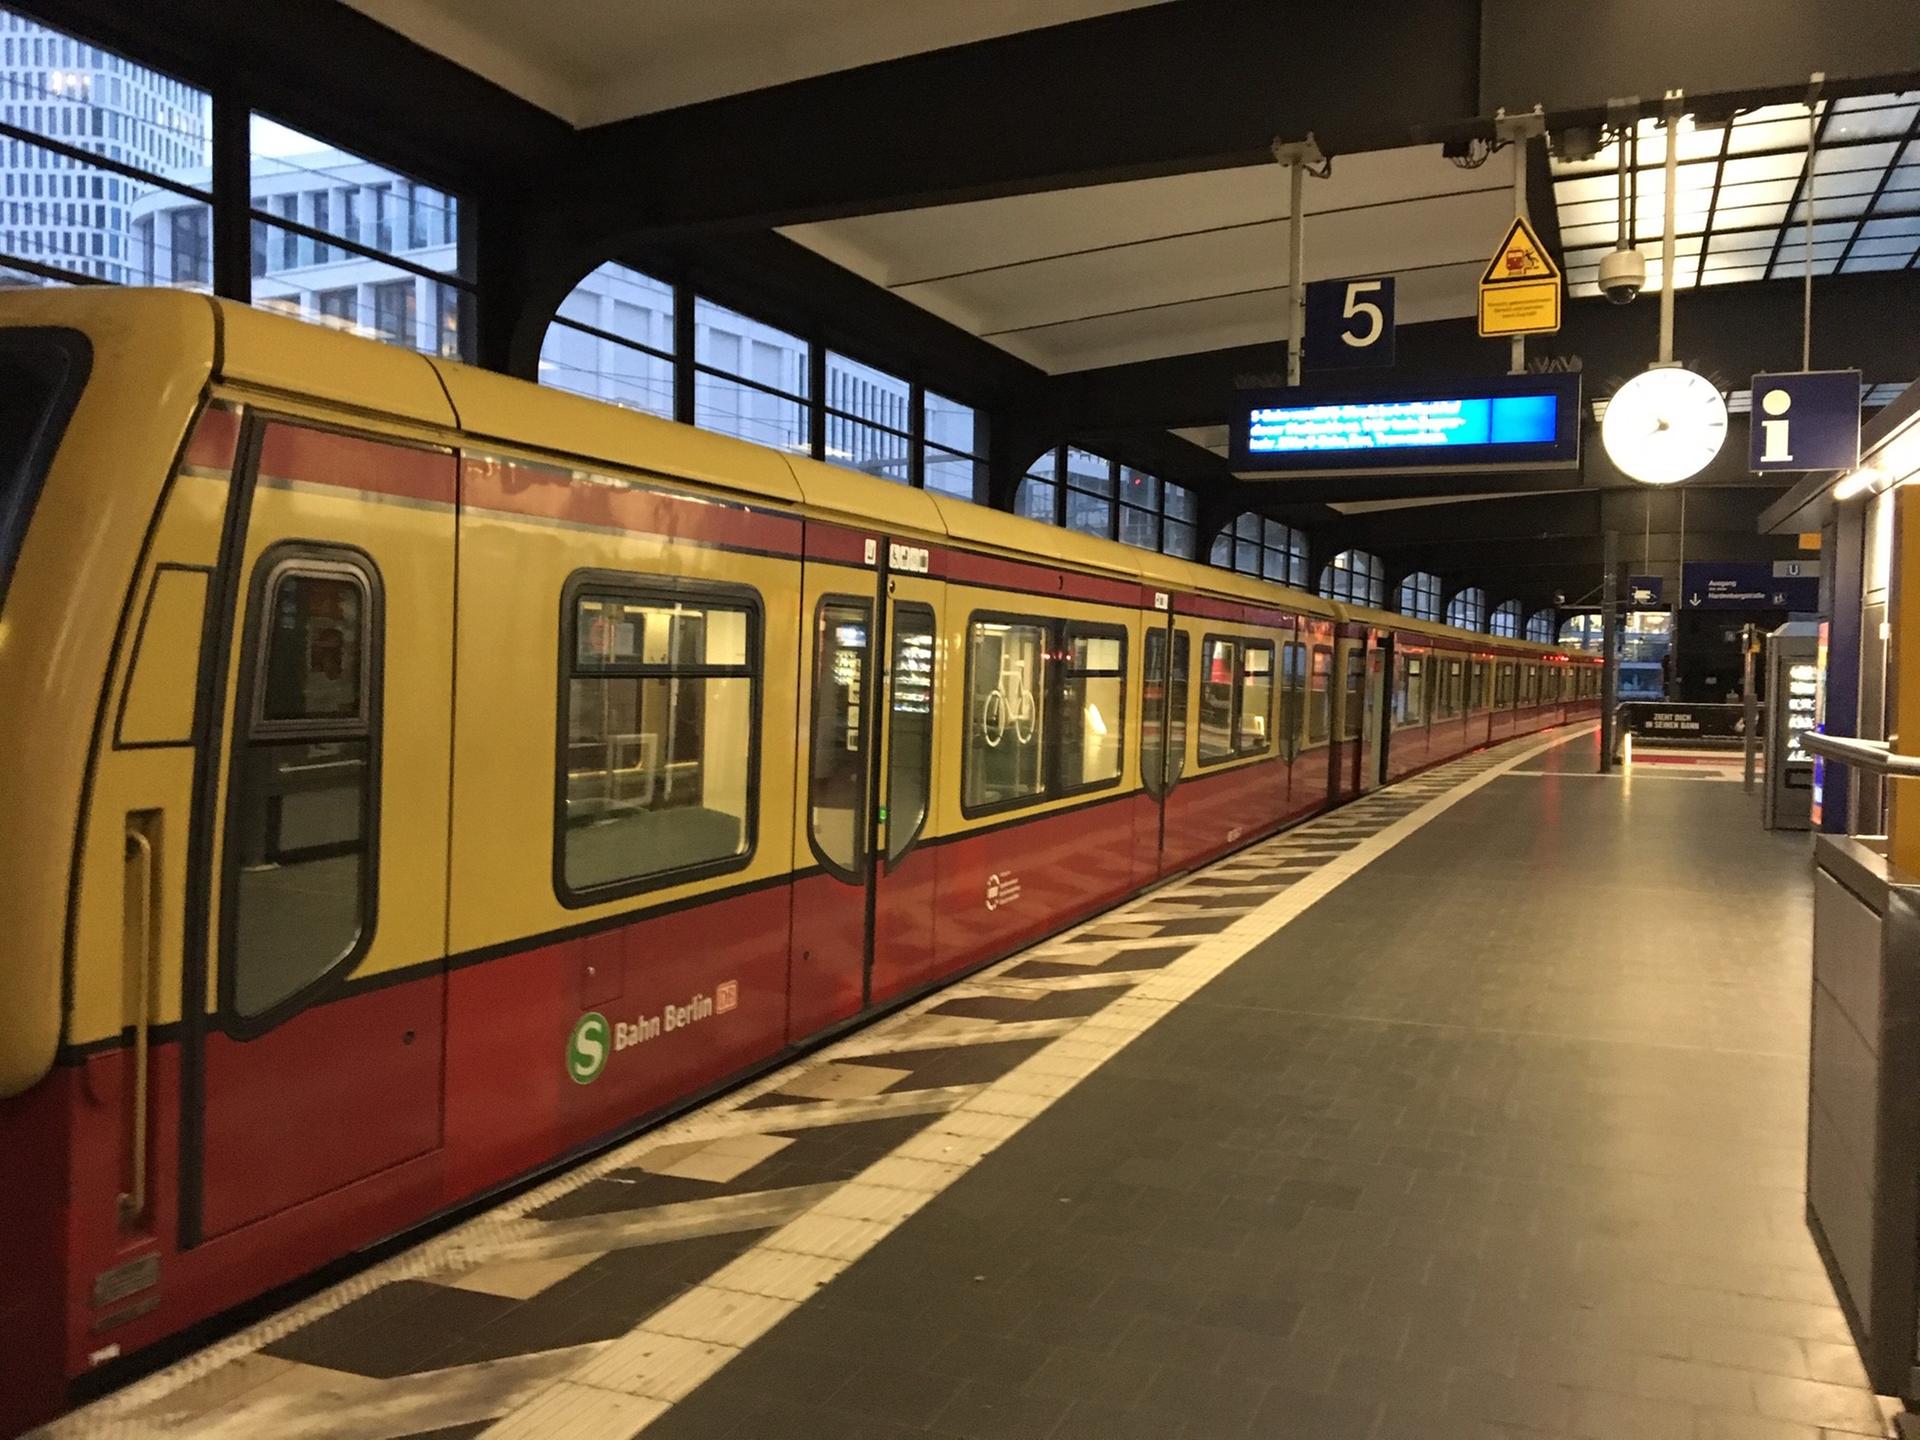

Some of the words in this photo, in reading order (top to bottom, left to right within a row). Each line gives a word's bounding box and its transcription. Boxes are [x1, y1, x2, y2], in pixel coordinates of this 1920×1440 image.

[1341, 280, 1384, 347] 5
[1788, 564, 1799, 576] U
[574, 1019, 604, 1077] S
[614, 1014, 661, 1051] Bahn
[663, 992, 713, 1032] Berlin
